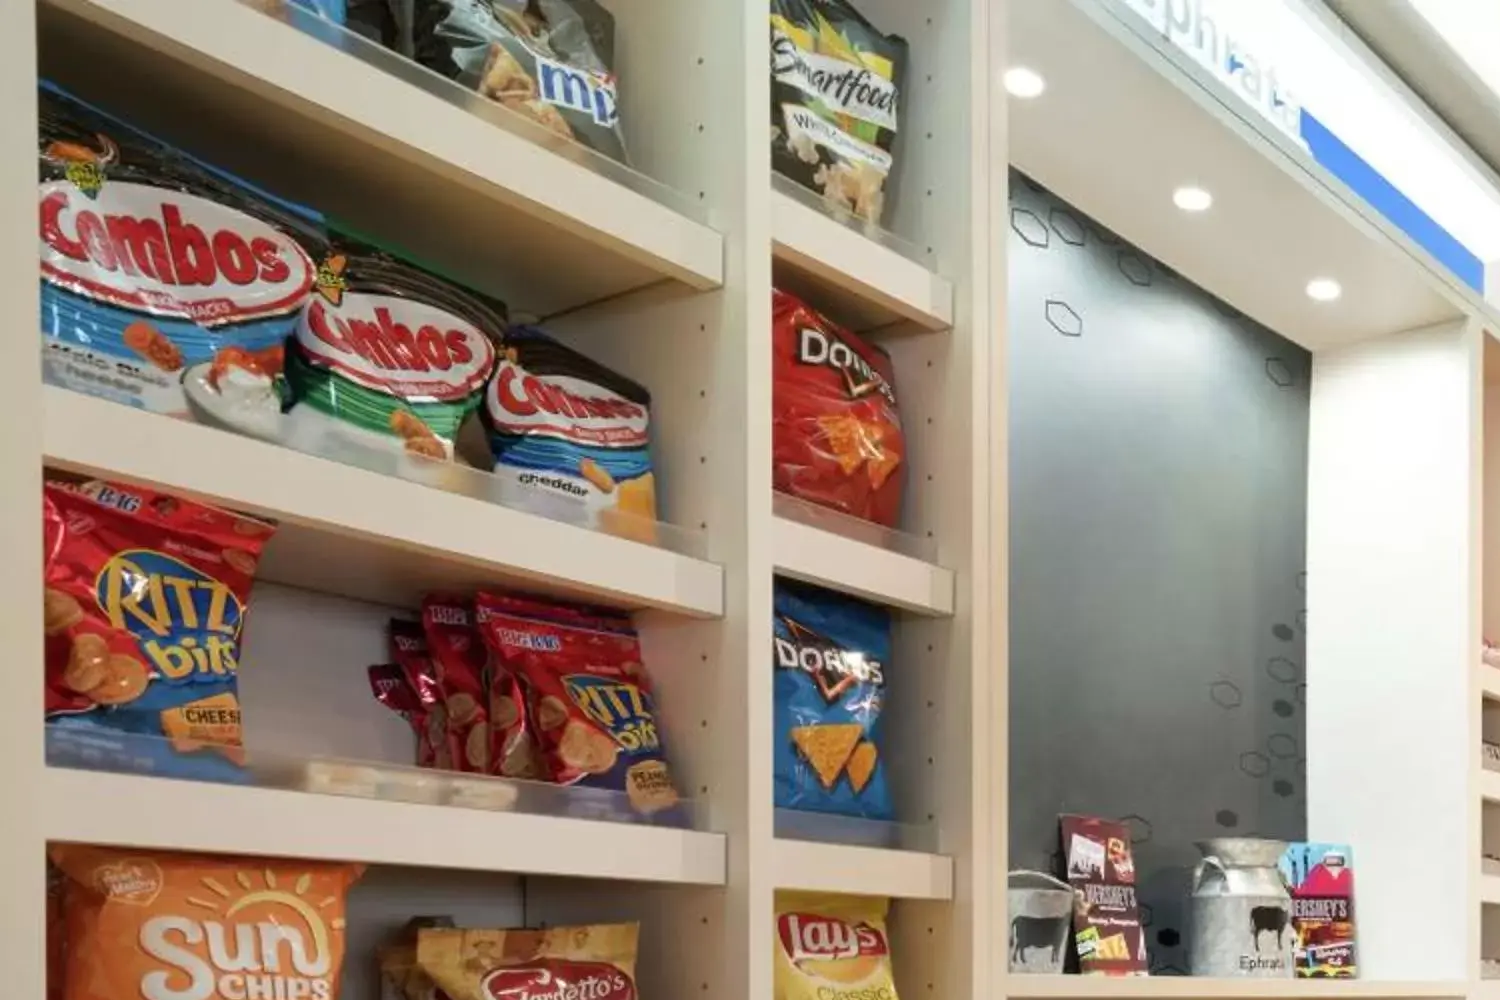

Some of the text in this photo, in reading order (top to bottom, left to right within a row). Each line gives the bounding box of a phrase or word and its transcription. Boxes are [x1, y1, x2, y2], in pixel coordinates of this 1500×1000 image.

[770, 37, 900, 113] Smartfood
[1143, 0, 1301, 132] phrata
[40, 191, 291, 287] Combos
[103, 555, 240, 637] RITZ
[144, 634, 238, 679] bits
